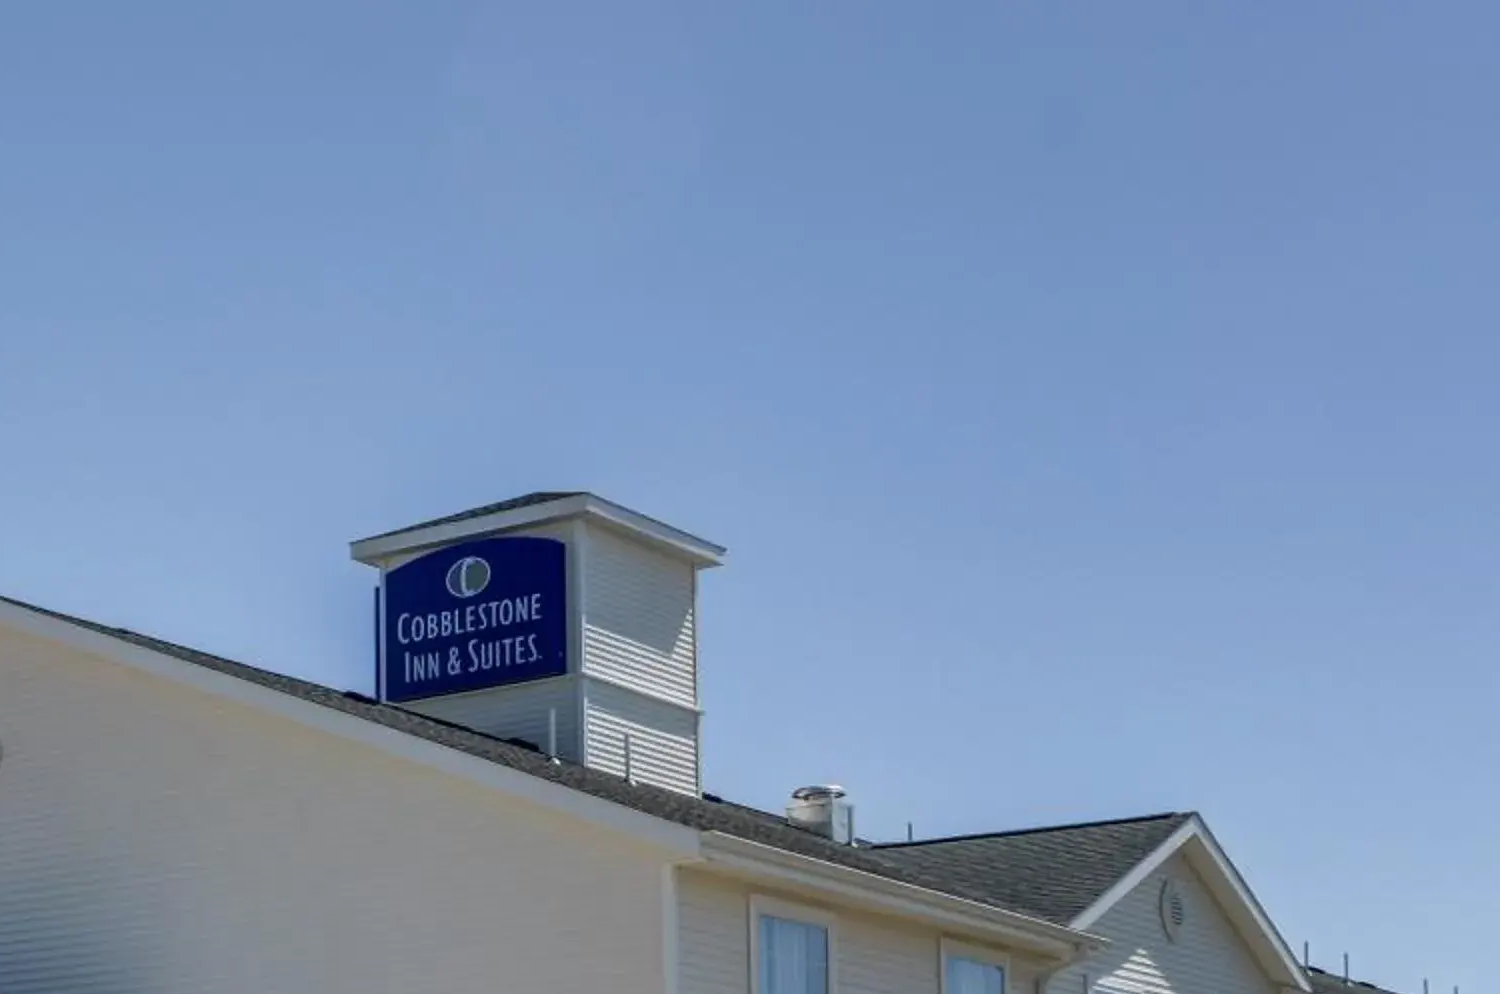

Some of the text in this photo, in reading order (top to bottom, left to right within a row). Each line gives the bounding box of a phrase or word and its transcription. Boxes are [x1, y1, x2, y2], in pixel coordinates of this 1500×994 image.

[397, 593, 543, 645] COBBLESTONE
[404, 651, 441, 683] INN
[447, 646, 462, 675] &
